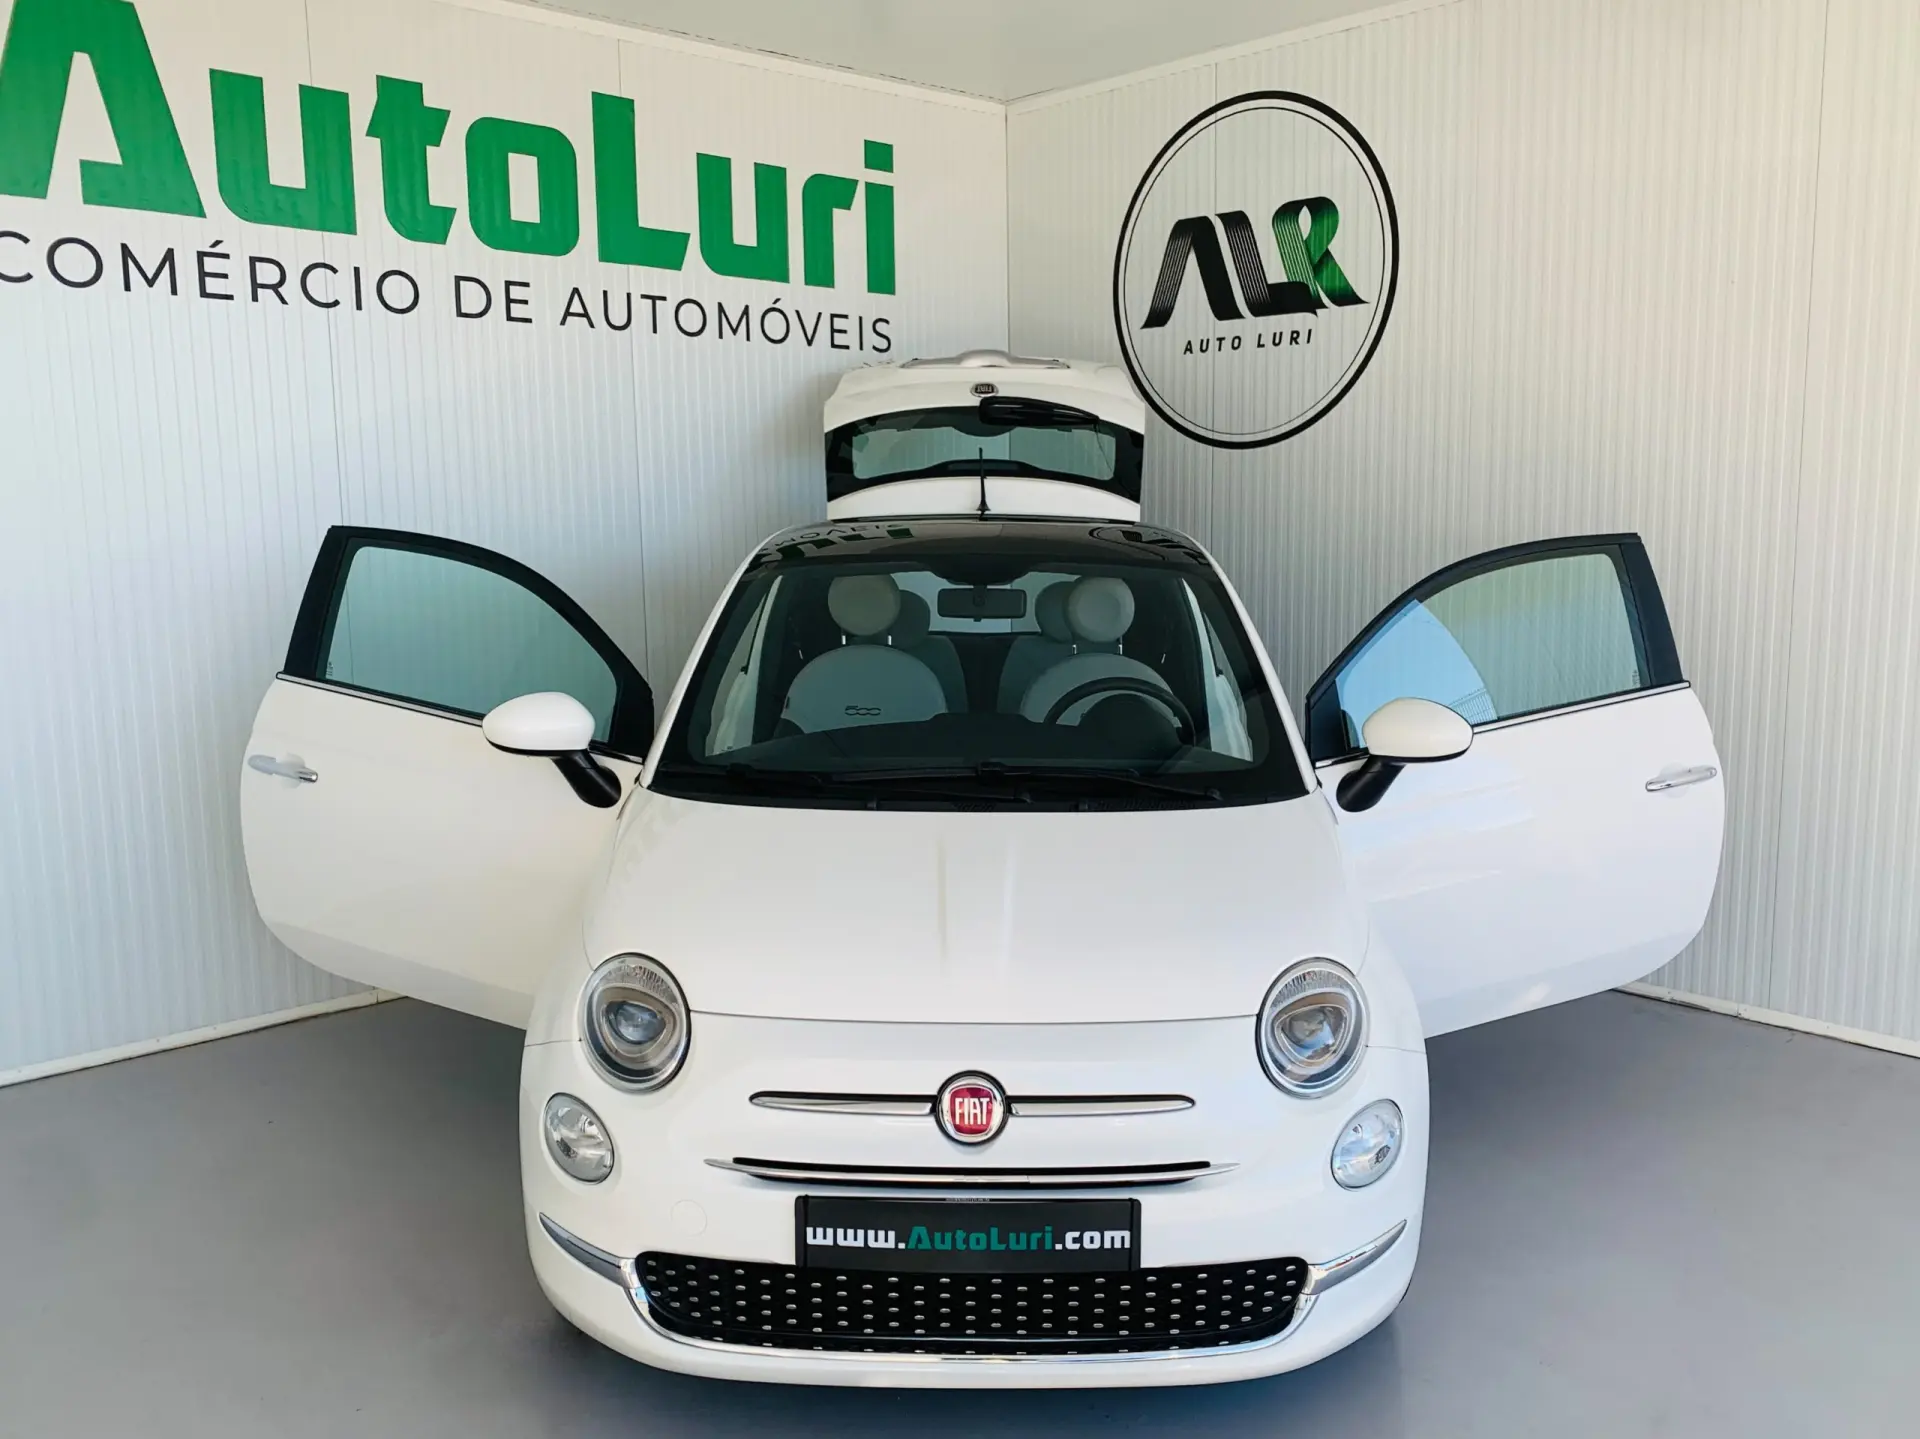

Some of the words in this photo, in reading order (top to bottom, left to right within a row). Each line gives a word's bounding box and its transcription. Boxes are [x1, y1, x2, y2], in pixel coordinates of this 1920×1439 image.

[0, 0, 896, 295] AutoLuri
[0, 230, 421, 315] COMÉRCIO
[455, 274, 534, 324] DE
[560, 286, 893, 353] AUTOMÓVEIS
[1183, 336, 1242, 355] AUTO
[1256, 328, 1313, 348] LURI
[845, 705, 881, 716] 500
[955, 1097, 990, 1125] FIAT
[806, 1226, 1132, 1251] www.AutoLuri.com
